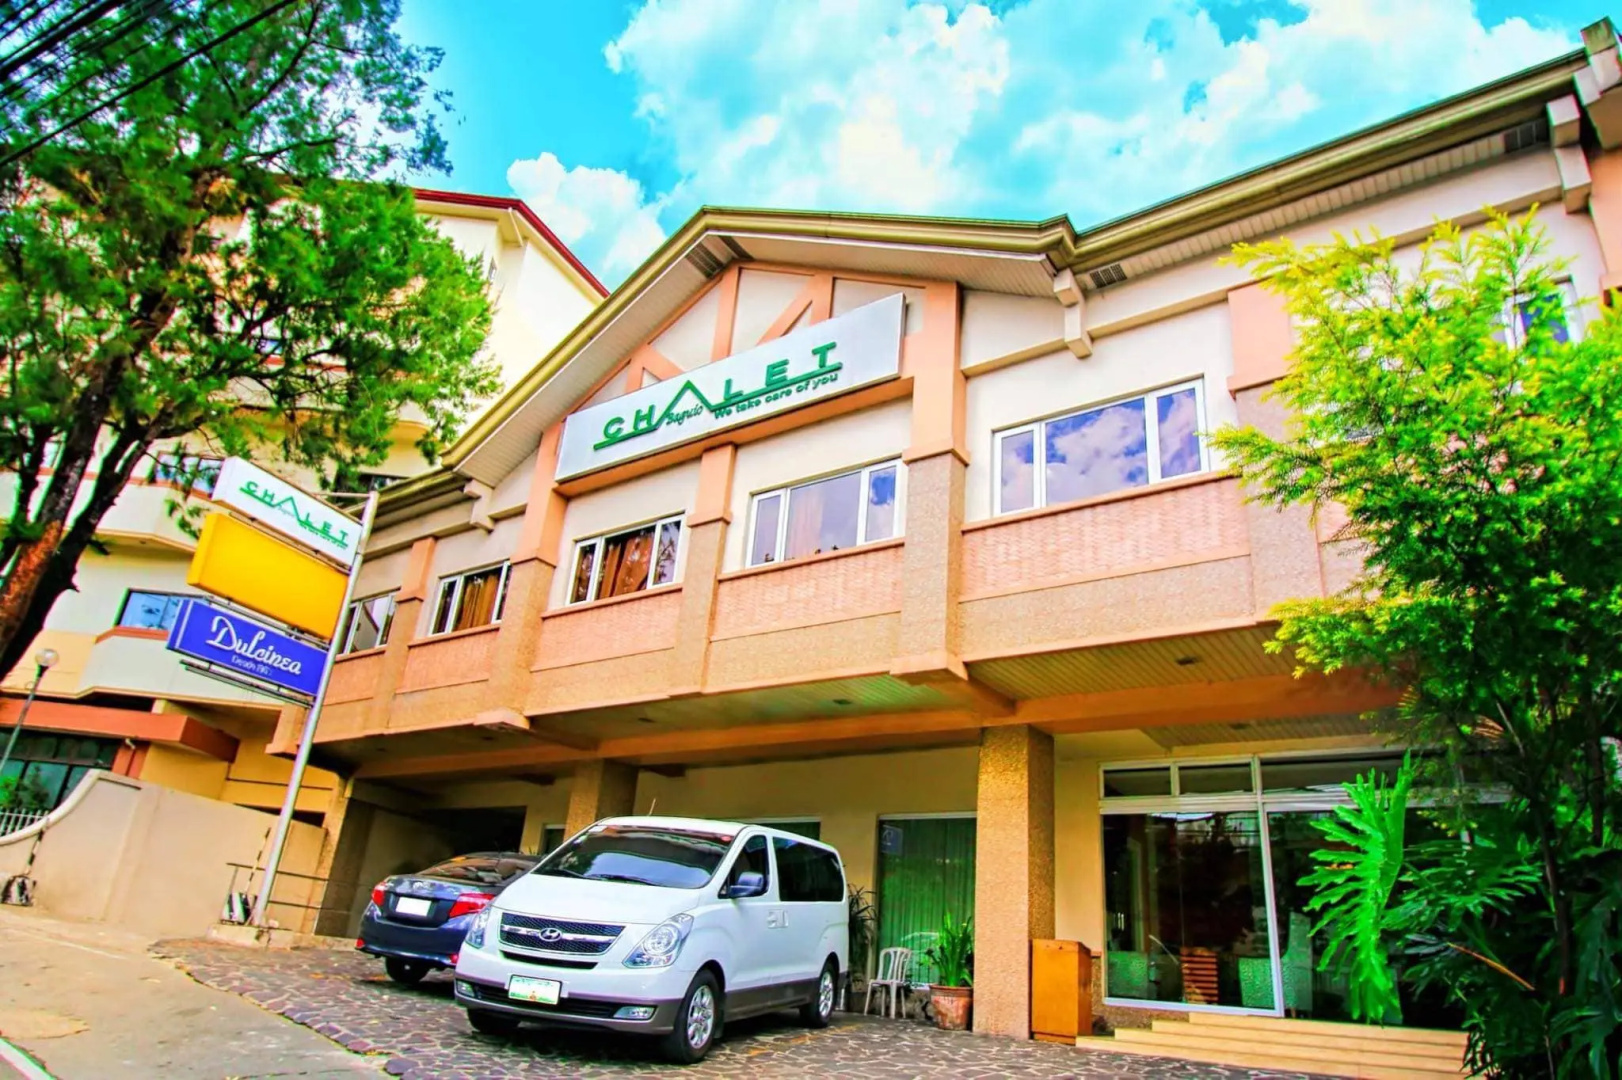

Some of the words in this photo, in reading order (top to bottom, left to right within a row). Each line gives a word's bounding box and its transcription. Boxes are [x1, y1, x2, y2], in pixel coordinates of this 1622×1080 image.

[594, 341, 842, 450] CHALET
[714, 409, 732, 420] We
[736, 398, 762, 414] take
[765, 388, 792, 403] care
[796, 381, 810, 393] of
[812, 373, 838, 390] you
[239, 480, 349, 547] CHALET
[205, 615, 302, 676] Dulcinea
